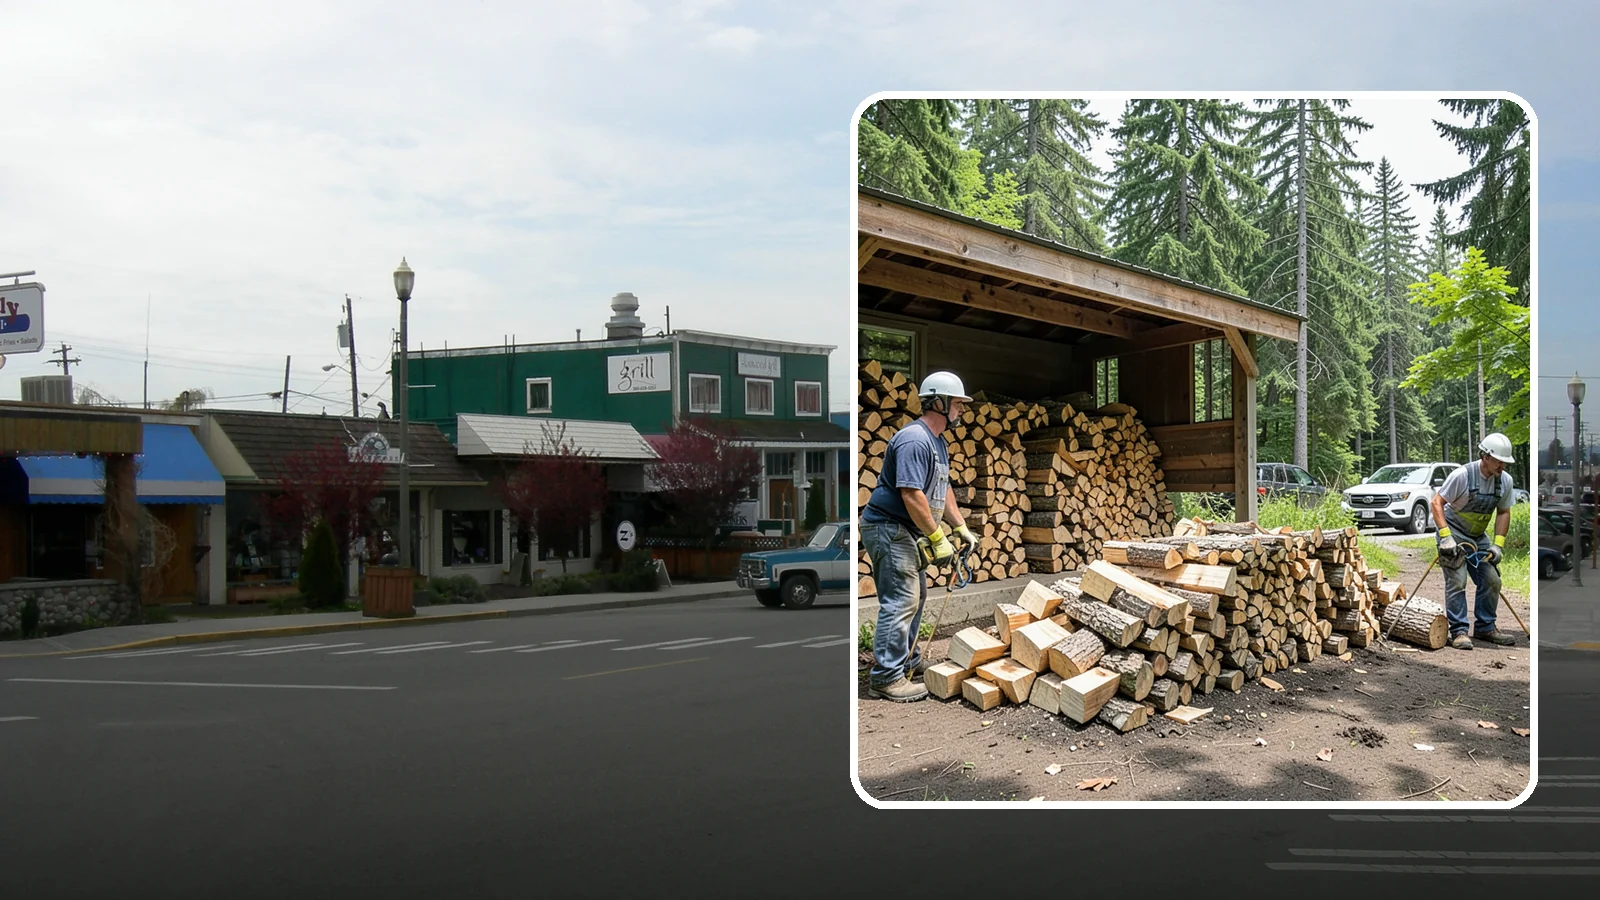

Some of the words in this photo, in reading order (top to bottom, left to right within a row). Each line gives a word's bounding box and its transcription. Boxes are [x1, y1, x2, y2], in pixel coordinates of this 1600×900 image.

[3, 338, 16, 346] Fries
[20, 337, 38, 345] Salads
[618, 356, 655, 391] grill
